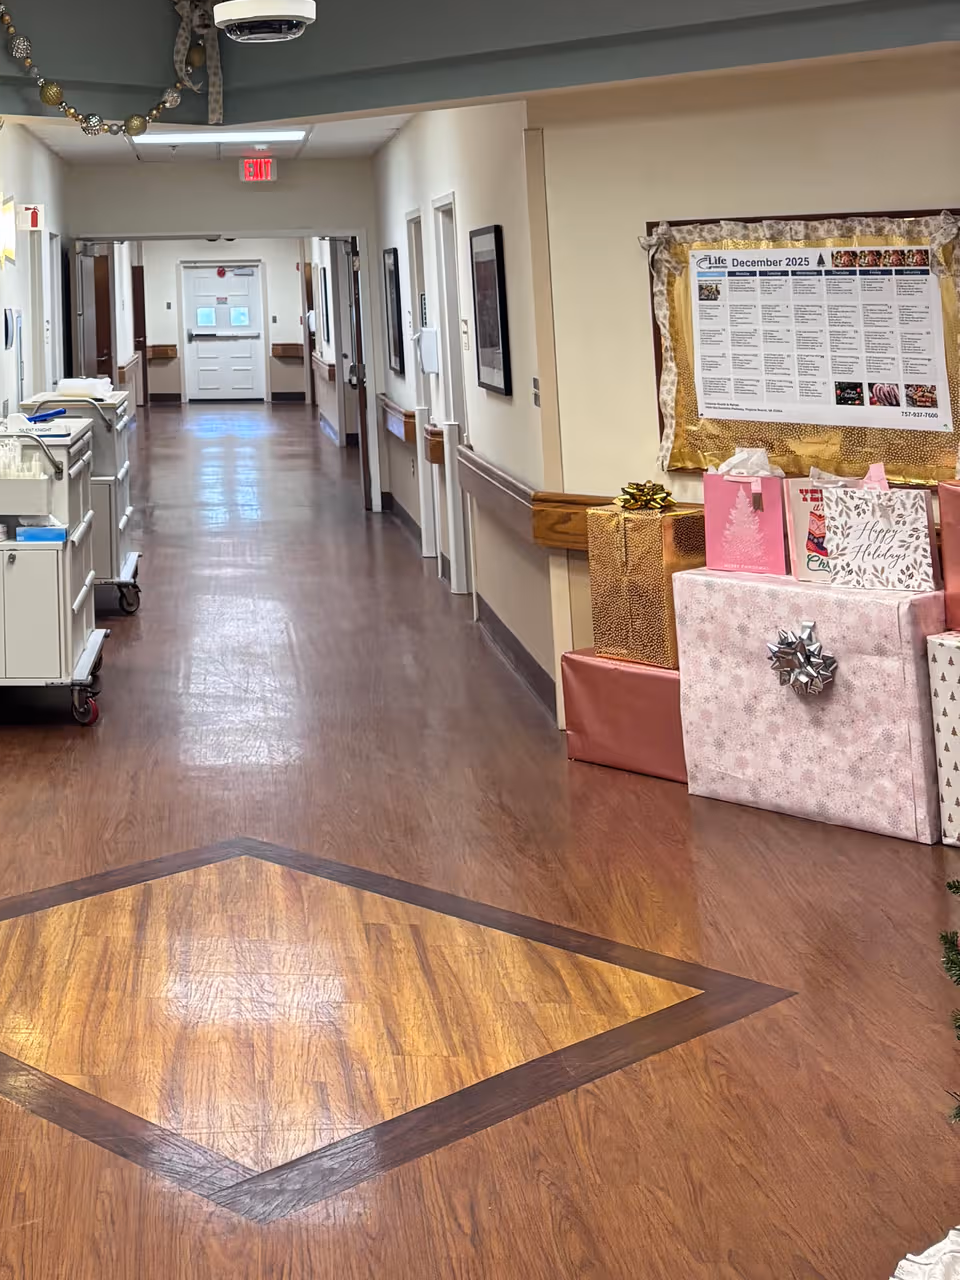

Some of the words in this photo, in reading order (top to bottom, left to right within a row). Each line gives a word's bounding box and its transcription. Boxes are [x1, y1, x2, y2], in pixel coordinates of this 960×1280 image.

[244, 159, 272, 181] EXIT
[708, 255, 727, 265] Life
[732, 258, 783, 267] December
[785, 257, 810, 267] 2025
[854, 520, 903, 544] Happy
[851, 543, 910, 570] Holidays
